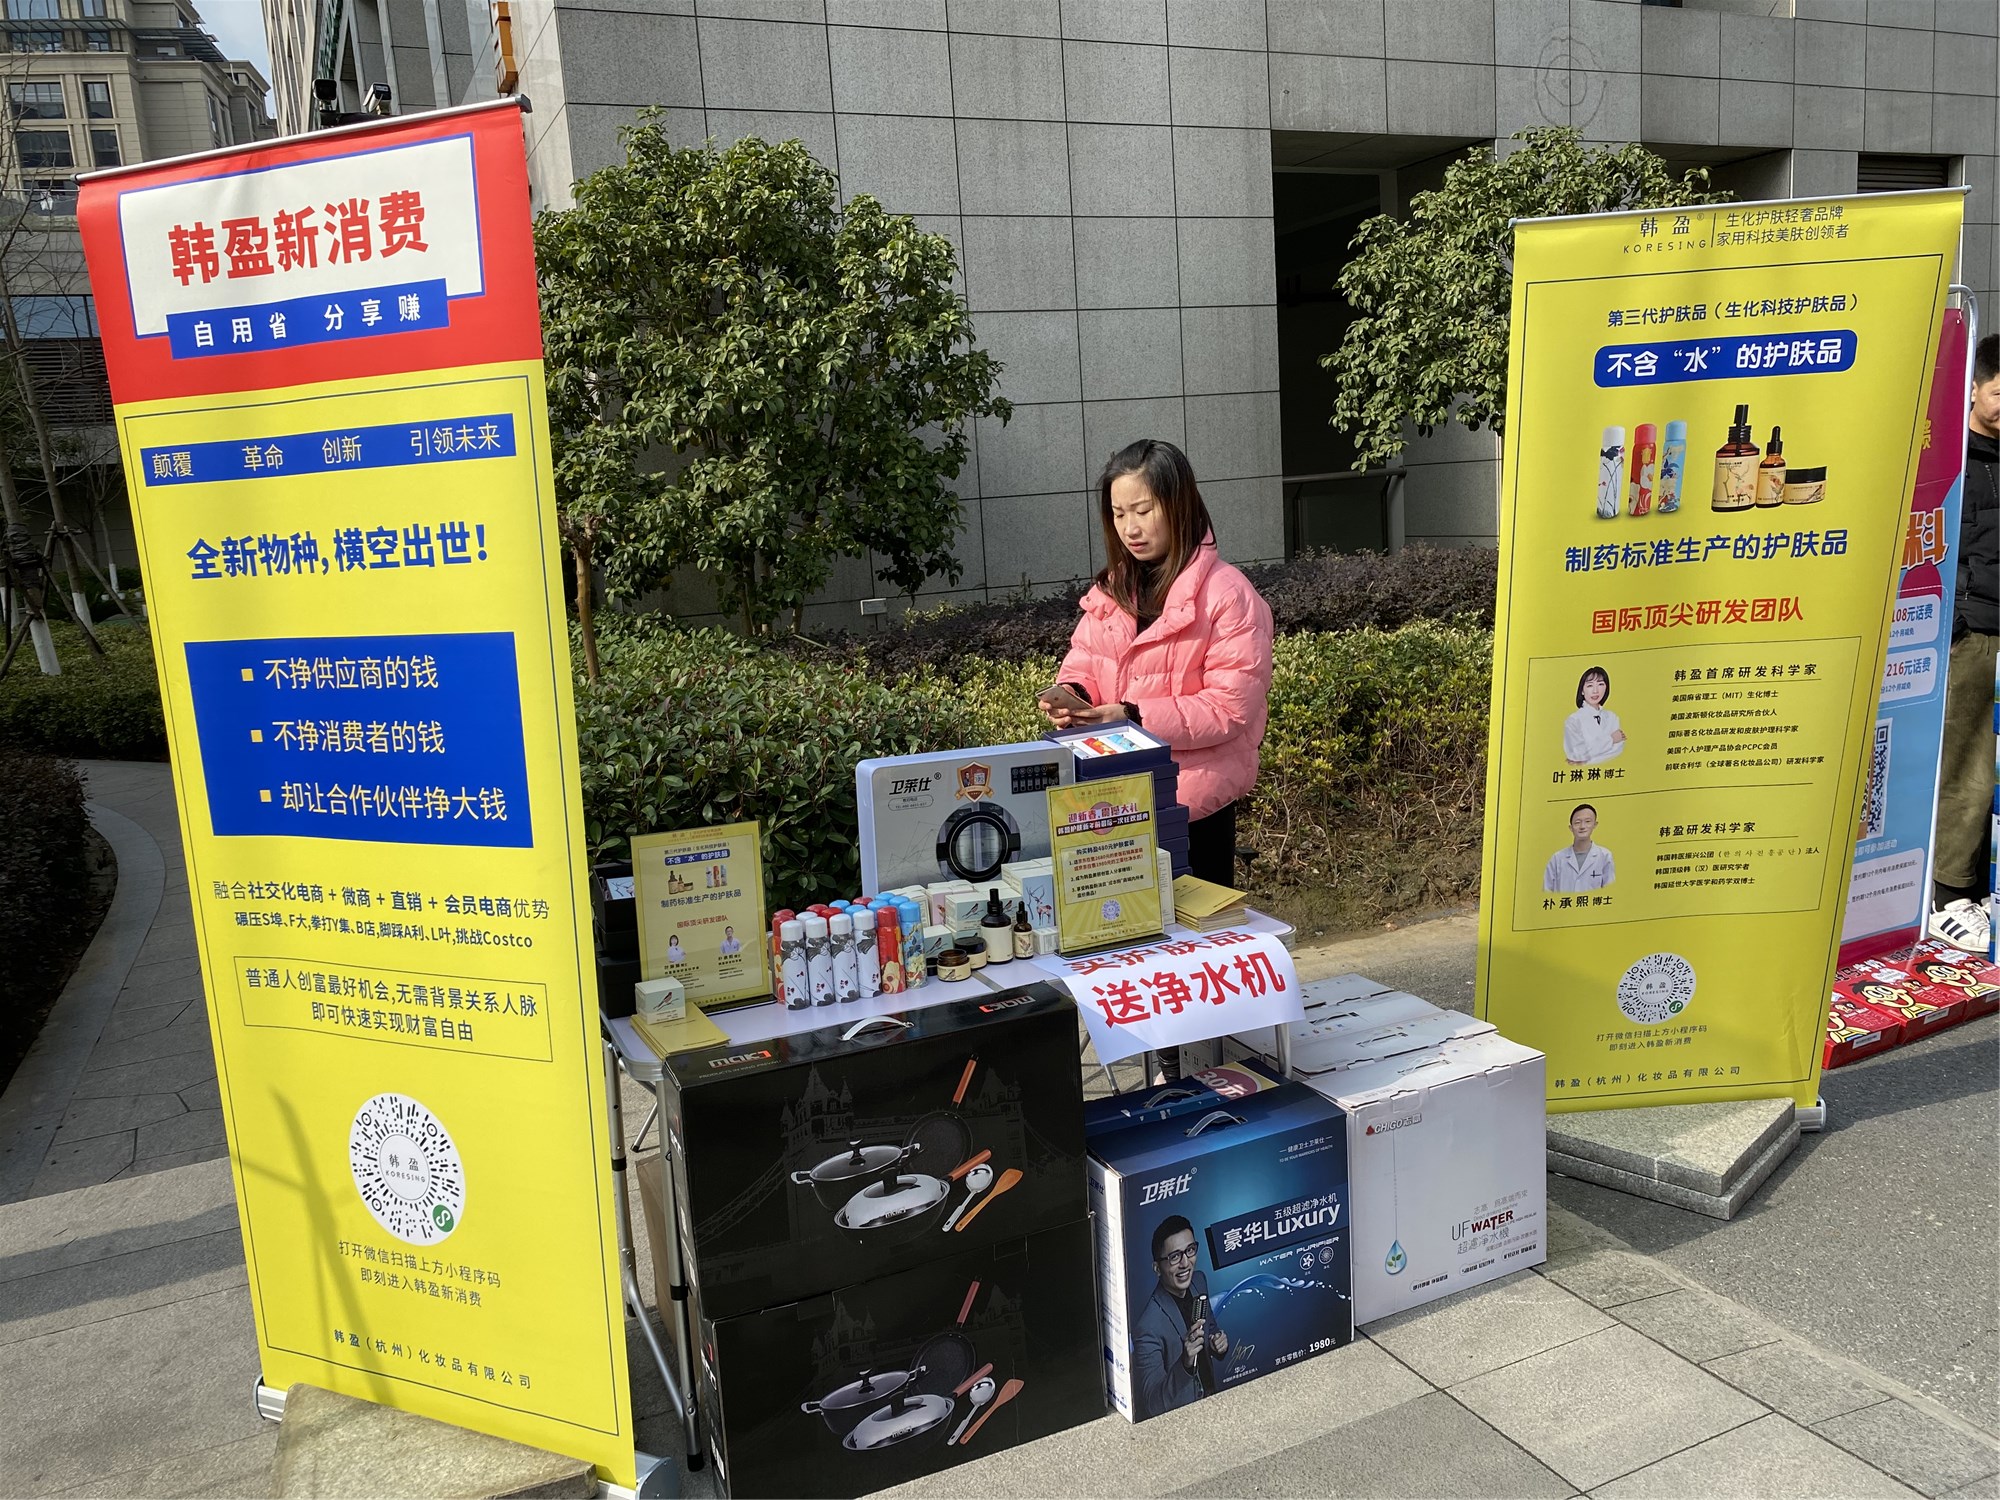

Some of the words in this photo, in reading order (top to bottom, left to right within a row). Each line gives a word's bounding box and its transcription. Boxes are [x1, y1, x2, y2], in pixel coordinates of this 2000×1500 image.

[1638, 213, 1692, 239] 韩盈
[1725, 204, 1844, 228] 生化护肤轻奢品牌
[167, 189, 429, 287] 韩盈新消费
[1622, 238, 1708, 255] KORESING
[1716, 223, 1850, 248] 家用科技美肤创领者
[193, 312, 287, 348] 自用省
[324, 293, 421, 333] 分享赚
[1607, 292, 1860, 328] 第三代护肤品（生化科技护肤品）
[152, 449, 194, 480] 颠覆
[243, 444, 284, 471] 革命
[322, 435, 362, 464] 创新
[410, 422, 502, 457] 引领未来
[186, 520, 489, 582] 全新物种,横空出世!
[1564, 528, 1849, 574] 制药标准生产的护肤品
[1591, 596, 1804, 635] 国际顶尖研发团队
[263, 654, 439, 691] 不挣供应商的钱
[1673, 663, 1818, 683] 韩盈首席研发科学家
[272, 719, 446, 755] 不挣消费者的钱
[888, 777, 932, 796] 卫莱仕
[1552, 768, 1602, 785] 叶琳琳
[1604, 767, 1626, 780] 博士
[280, 780, 508, 822] 却让合作伙伴挣大钱
[1658, 821, 1757, 839] 韩盈研发科学家
[213, 880, 325, 904] 融合社交化电商
[341, 886, 372, 908] 微商
[390, 890, 423, 913] 直销
[444, 895, 551, 921] 会员电商优势
[660, 888, 742, 909] 制药标准生产的护肤品
[1592, 894, 1614, 907] 博士
[676, 914, 729, 929] 国际顶尖研发团队
[1063, 930, 1258, 976] 买护肤品
[245, 967, 538, 1018] 普通人创富最好机会,无需背景关系人脉
[1091, 950, 1288, 1029] 送净水机
[311, 1001, 474, 1043] 即可快速实现财富自由
[1596, 1024, 1708, 1042] 打开微信扫描上方小程序码
[1608, 1036, 1692, 1052] 即刻进入韩盈新消费
[1554, 1065, 1742, 1089] 韩盈（杭州）化妆品有限公司
[385, 1169, 427, 1184] KORESING
[388, 1152, 420, 1173] 韩盈
[1140, 1173, 1193, 1207] 卫莱仕
[1273, 1191, 1338, 1222] 五级超滤净水机
[1222, 1203, 1342, 1253] 豪华Luxury
[1451, 1219, 1471, 1241] UF
[1471, 1209, 1514, 1233] WATER
[338, 1239, 502, 1290] 打开微信扫描上方小程序码
[1259, 1249, 1294, 1267] WATER
[1296, 1235, 1340, 1255] PURIFIER
[360, 1266, 483, 1308] 即刻进入韩盈新消费
[333, 1327, 533, 1391] 韩盈（杭州）化妆品有限公司
[1308, 1337, 1337, 1353] 1980元
